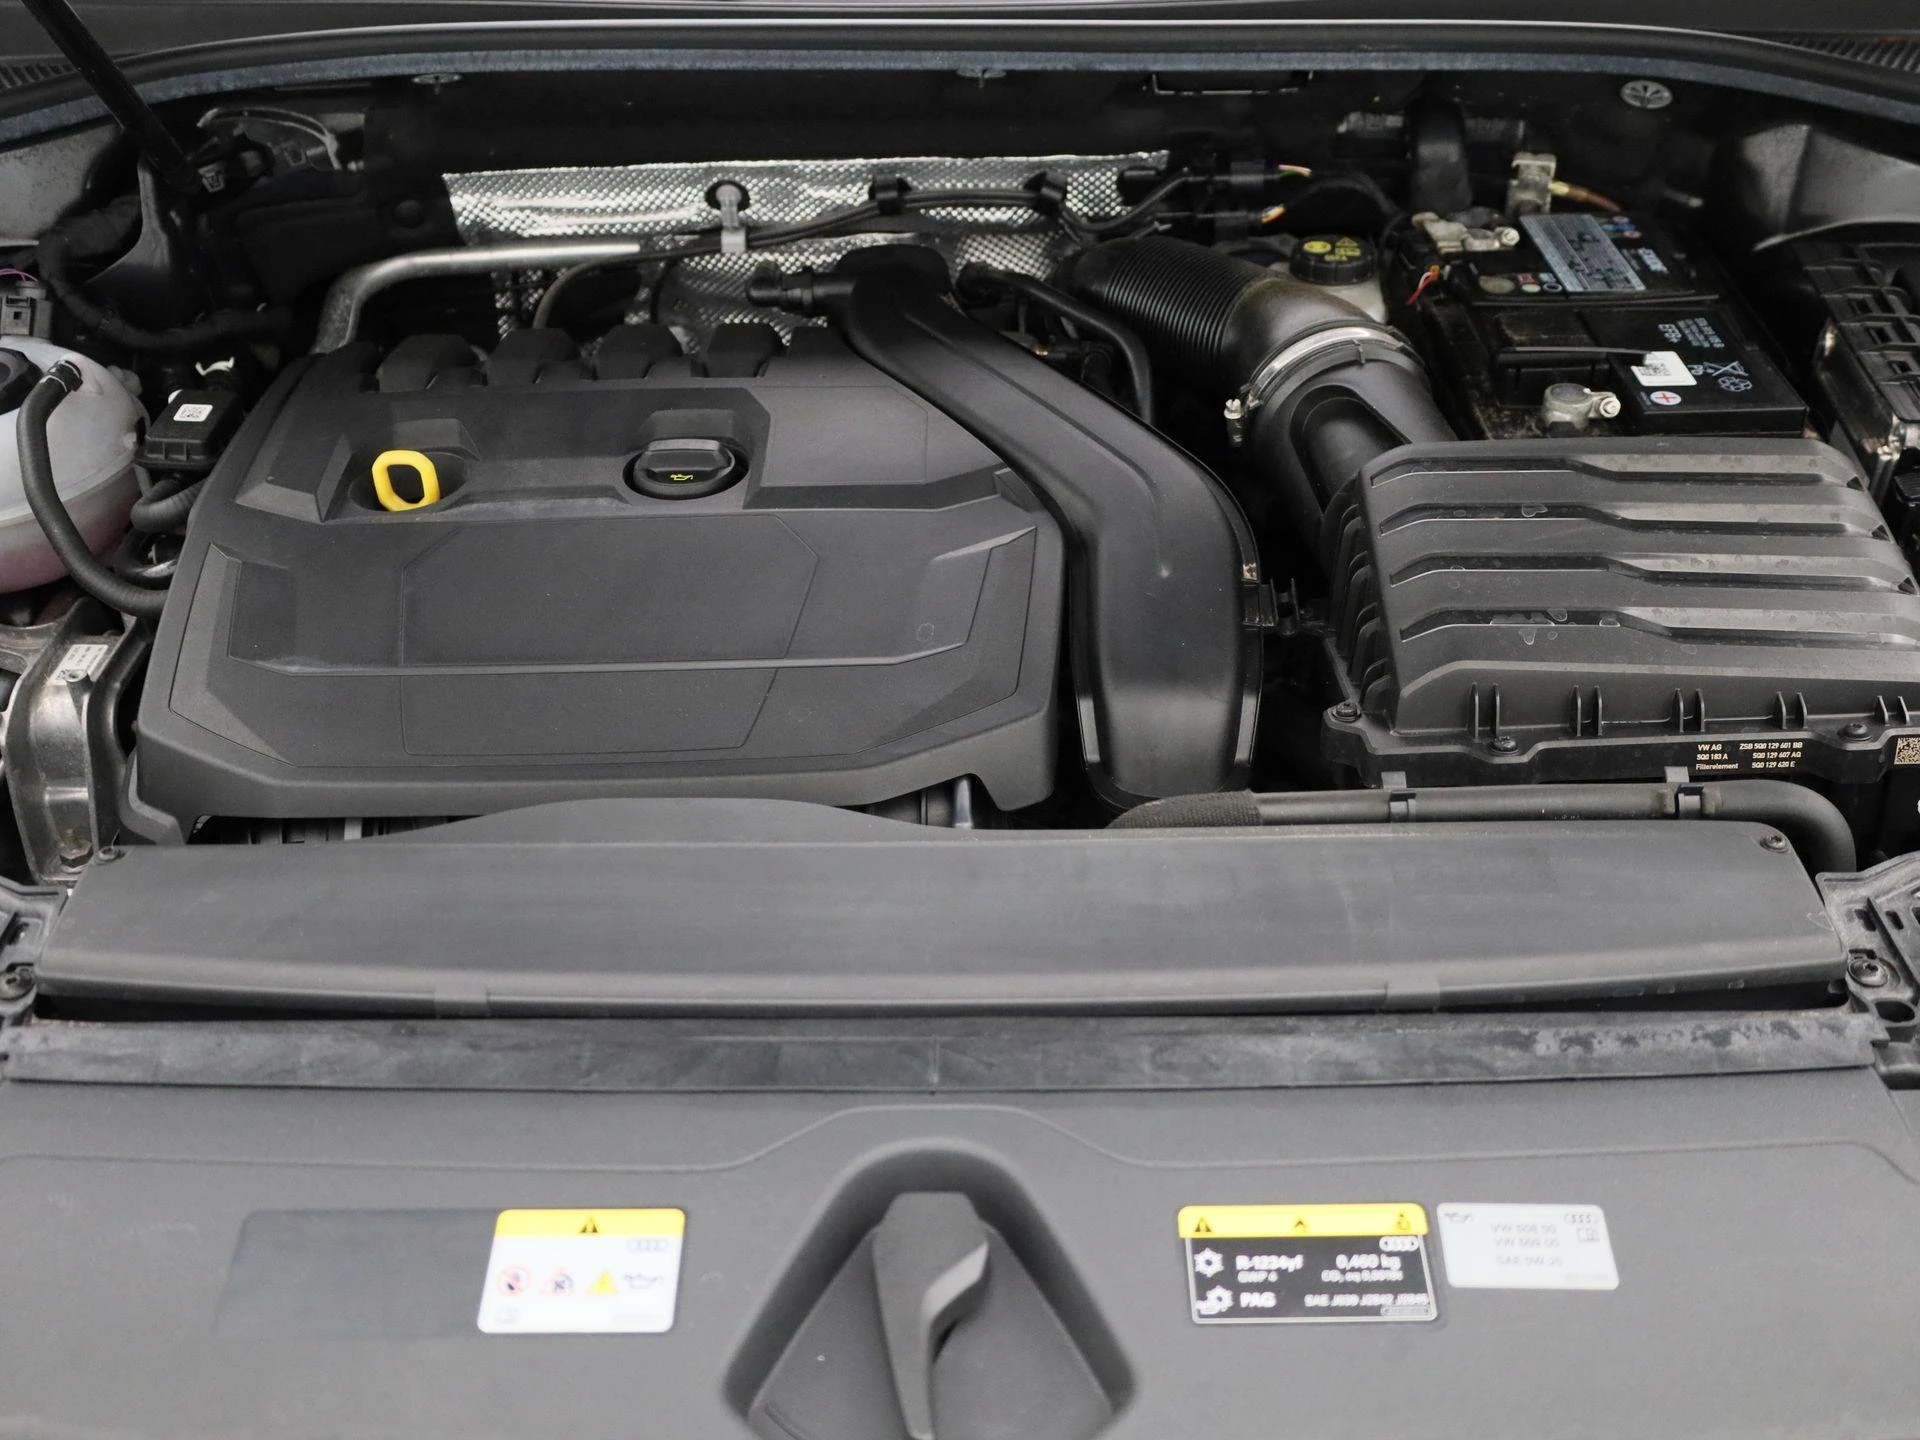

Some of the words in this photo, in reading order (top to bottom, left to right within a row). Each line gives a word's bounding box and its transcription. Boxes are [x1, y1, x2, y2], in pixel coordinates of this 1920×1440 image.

[1710, 743, 1723, 751] AG
[1739, 742, 1753, 750] ZSB
[1780, 741, 1791, 749] 601
[1710, 752, 1722, 760] 183
[1722, 752, 1729, 760] A
[1766, 751, 1778, 759] 129
[1695, 762, 1739, 770] Filterelement
[1765, 761, 1778, 769] 129
[1777, 760, 1790, 768] 620
